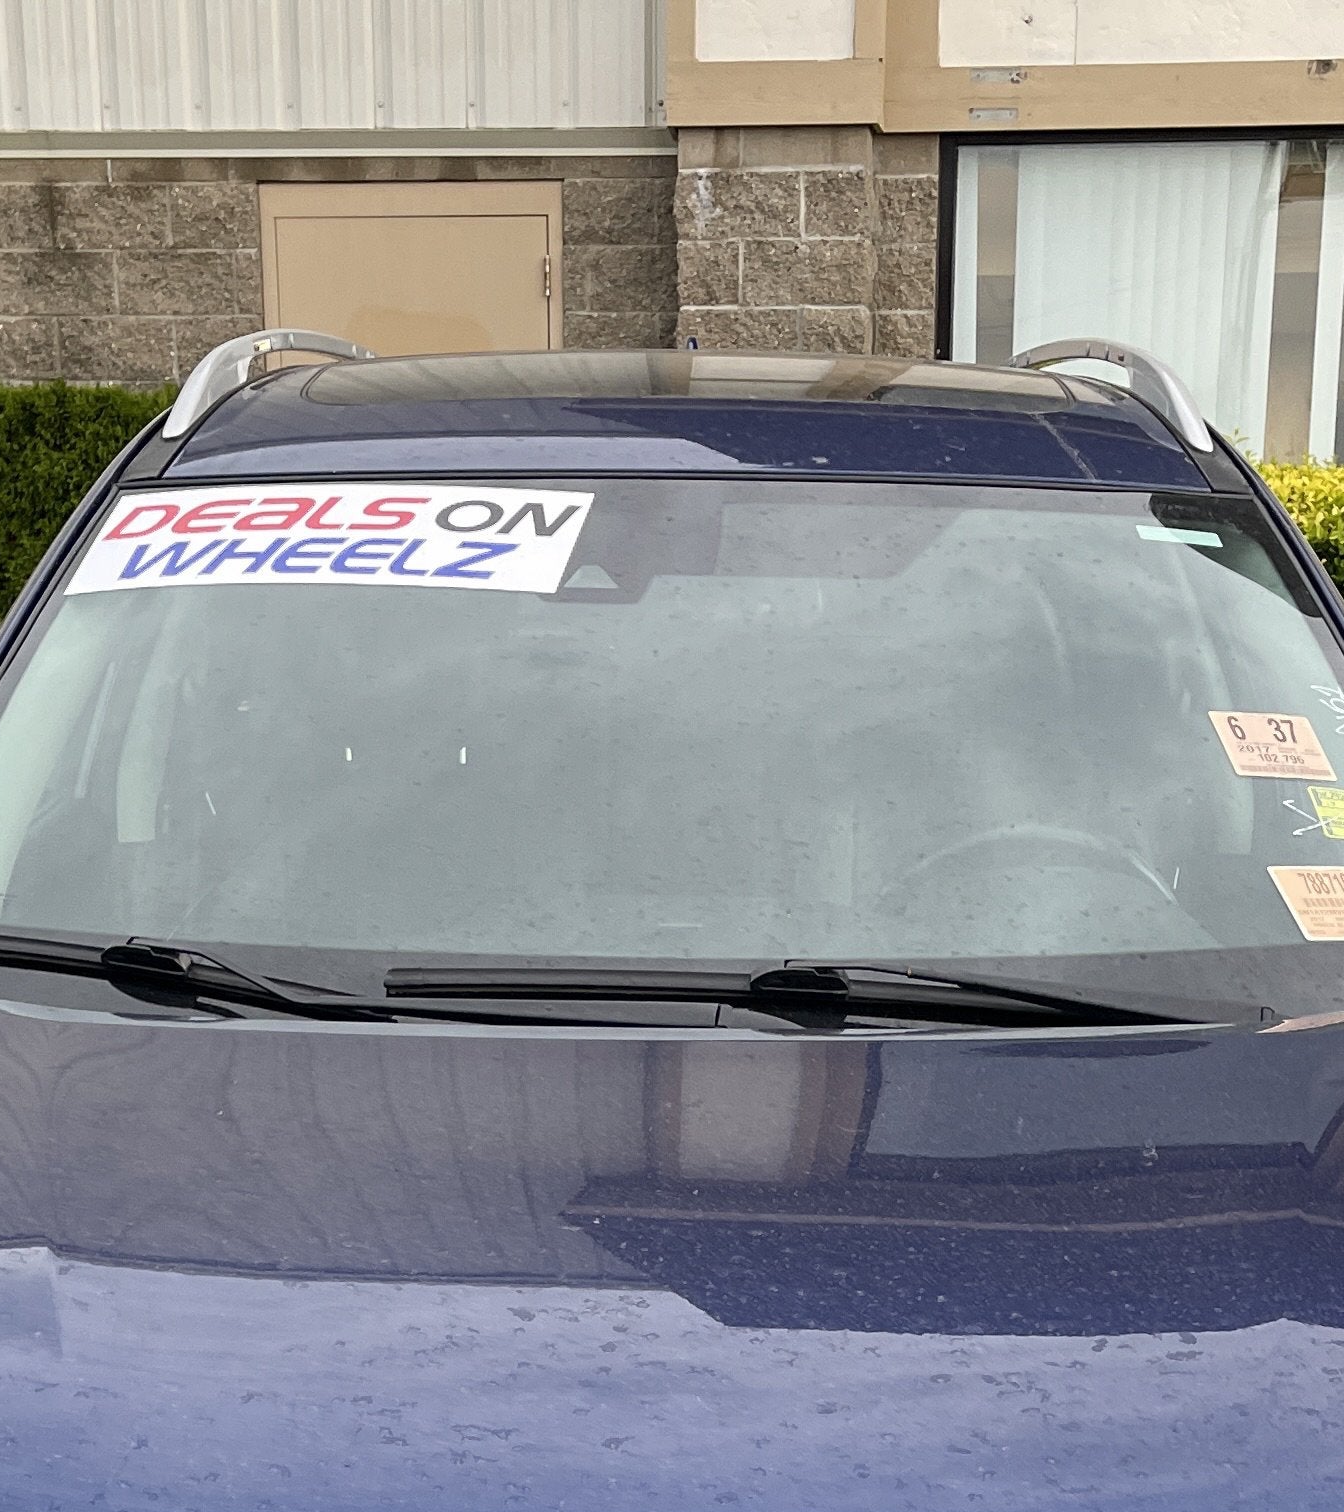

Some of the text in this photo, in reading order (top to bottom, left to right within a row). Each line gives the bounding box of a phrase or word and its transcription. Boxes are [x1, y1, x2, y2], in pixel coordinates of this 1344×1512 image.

[102, 496, 583, 542] DEALS ON
[116, 537, 523, 581] WHEELZ
[1226, 715, 1298, 744] 6 37
[1237, 744, 1271, 754] 2017
